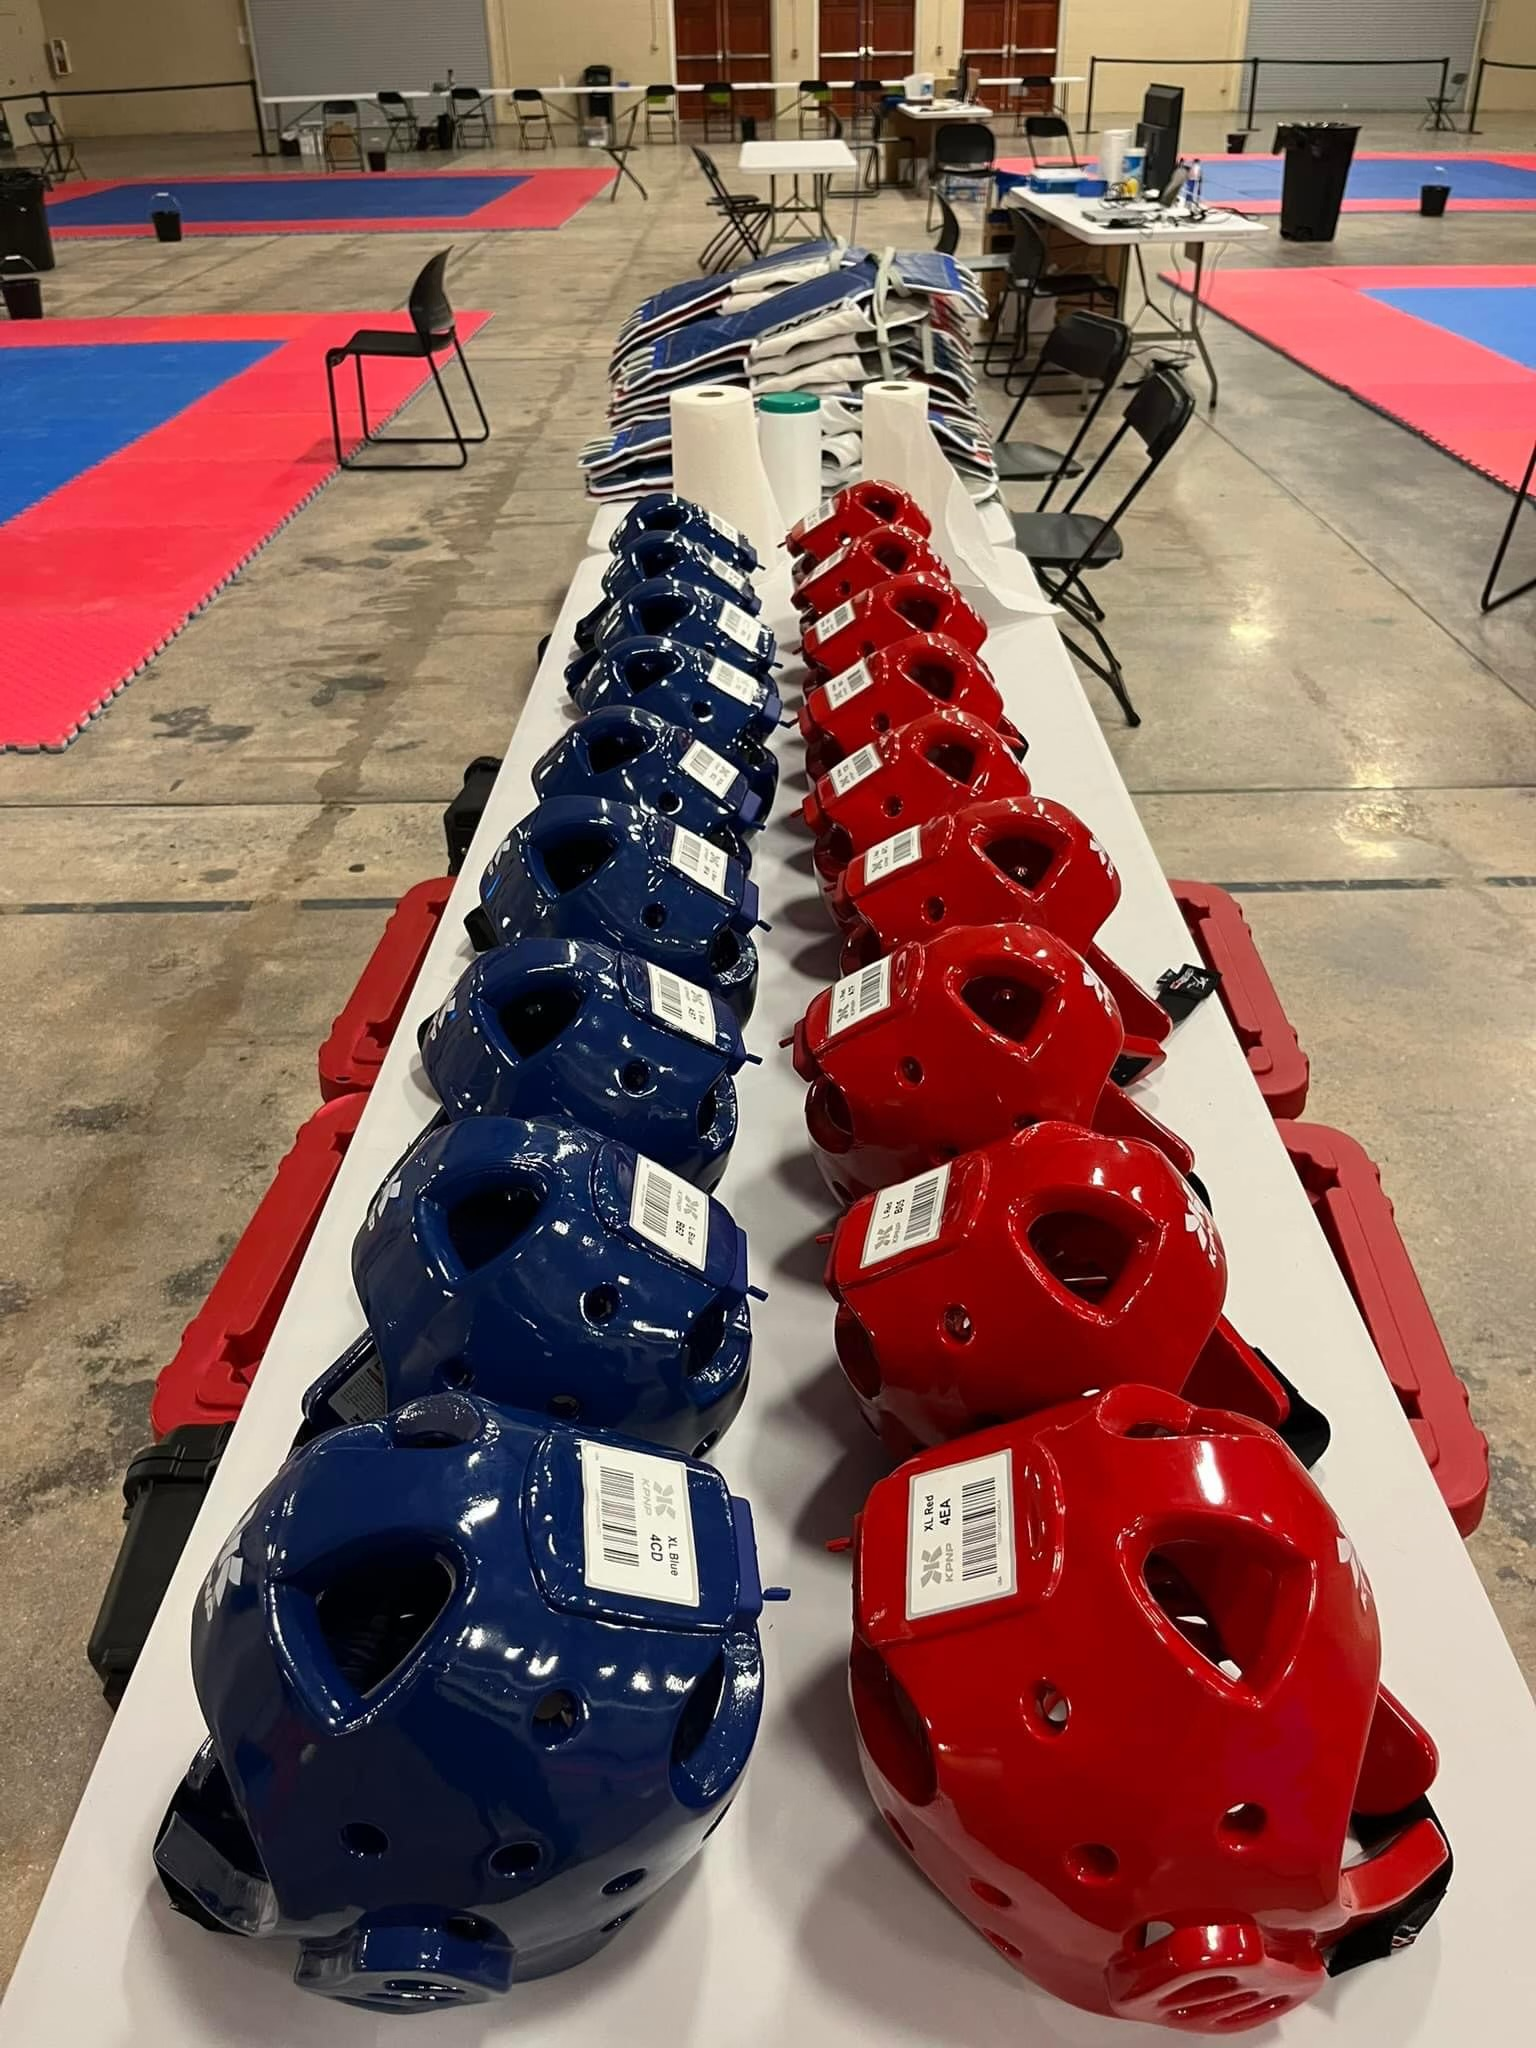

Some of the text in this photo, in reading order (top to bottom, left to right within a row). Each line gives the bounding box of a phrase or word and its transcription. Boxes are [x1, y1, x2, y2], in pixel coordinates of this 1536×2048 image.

[641, 1477, 653, 1517] KPNP
[924, 1494, 933, 1532] XL Red
[939, 1498, 950, 1527] 4EA
[649, 1534, 663, 1562] 4CD
[667, 1535, 680, 1576] XL Blue
[945, 1542, 954, 1582] KPNP
